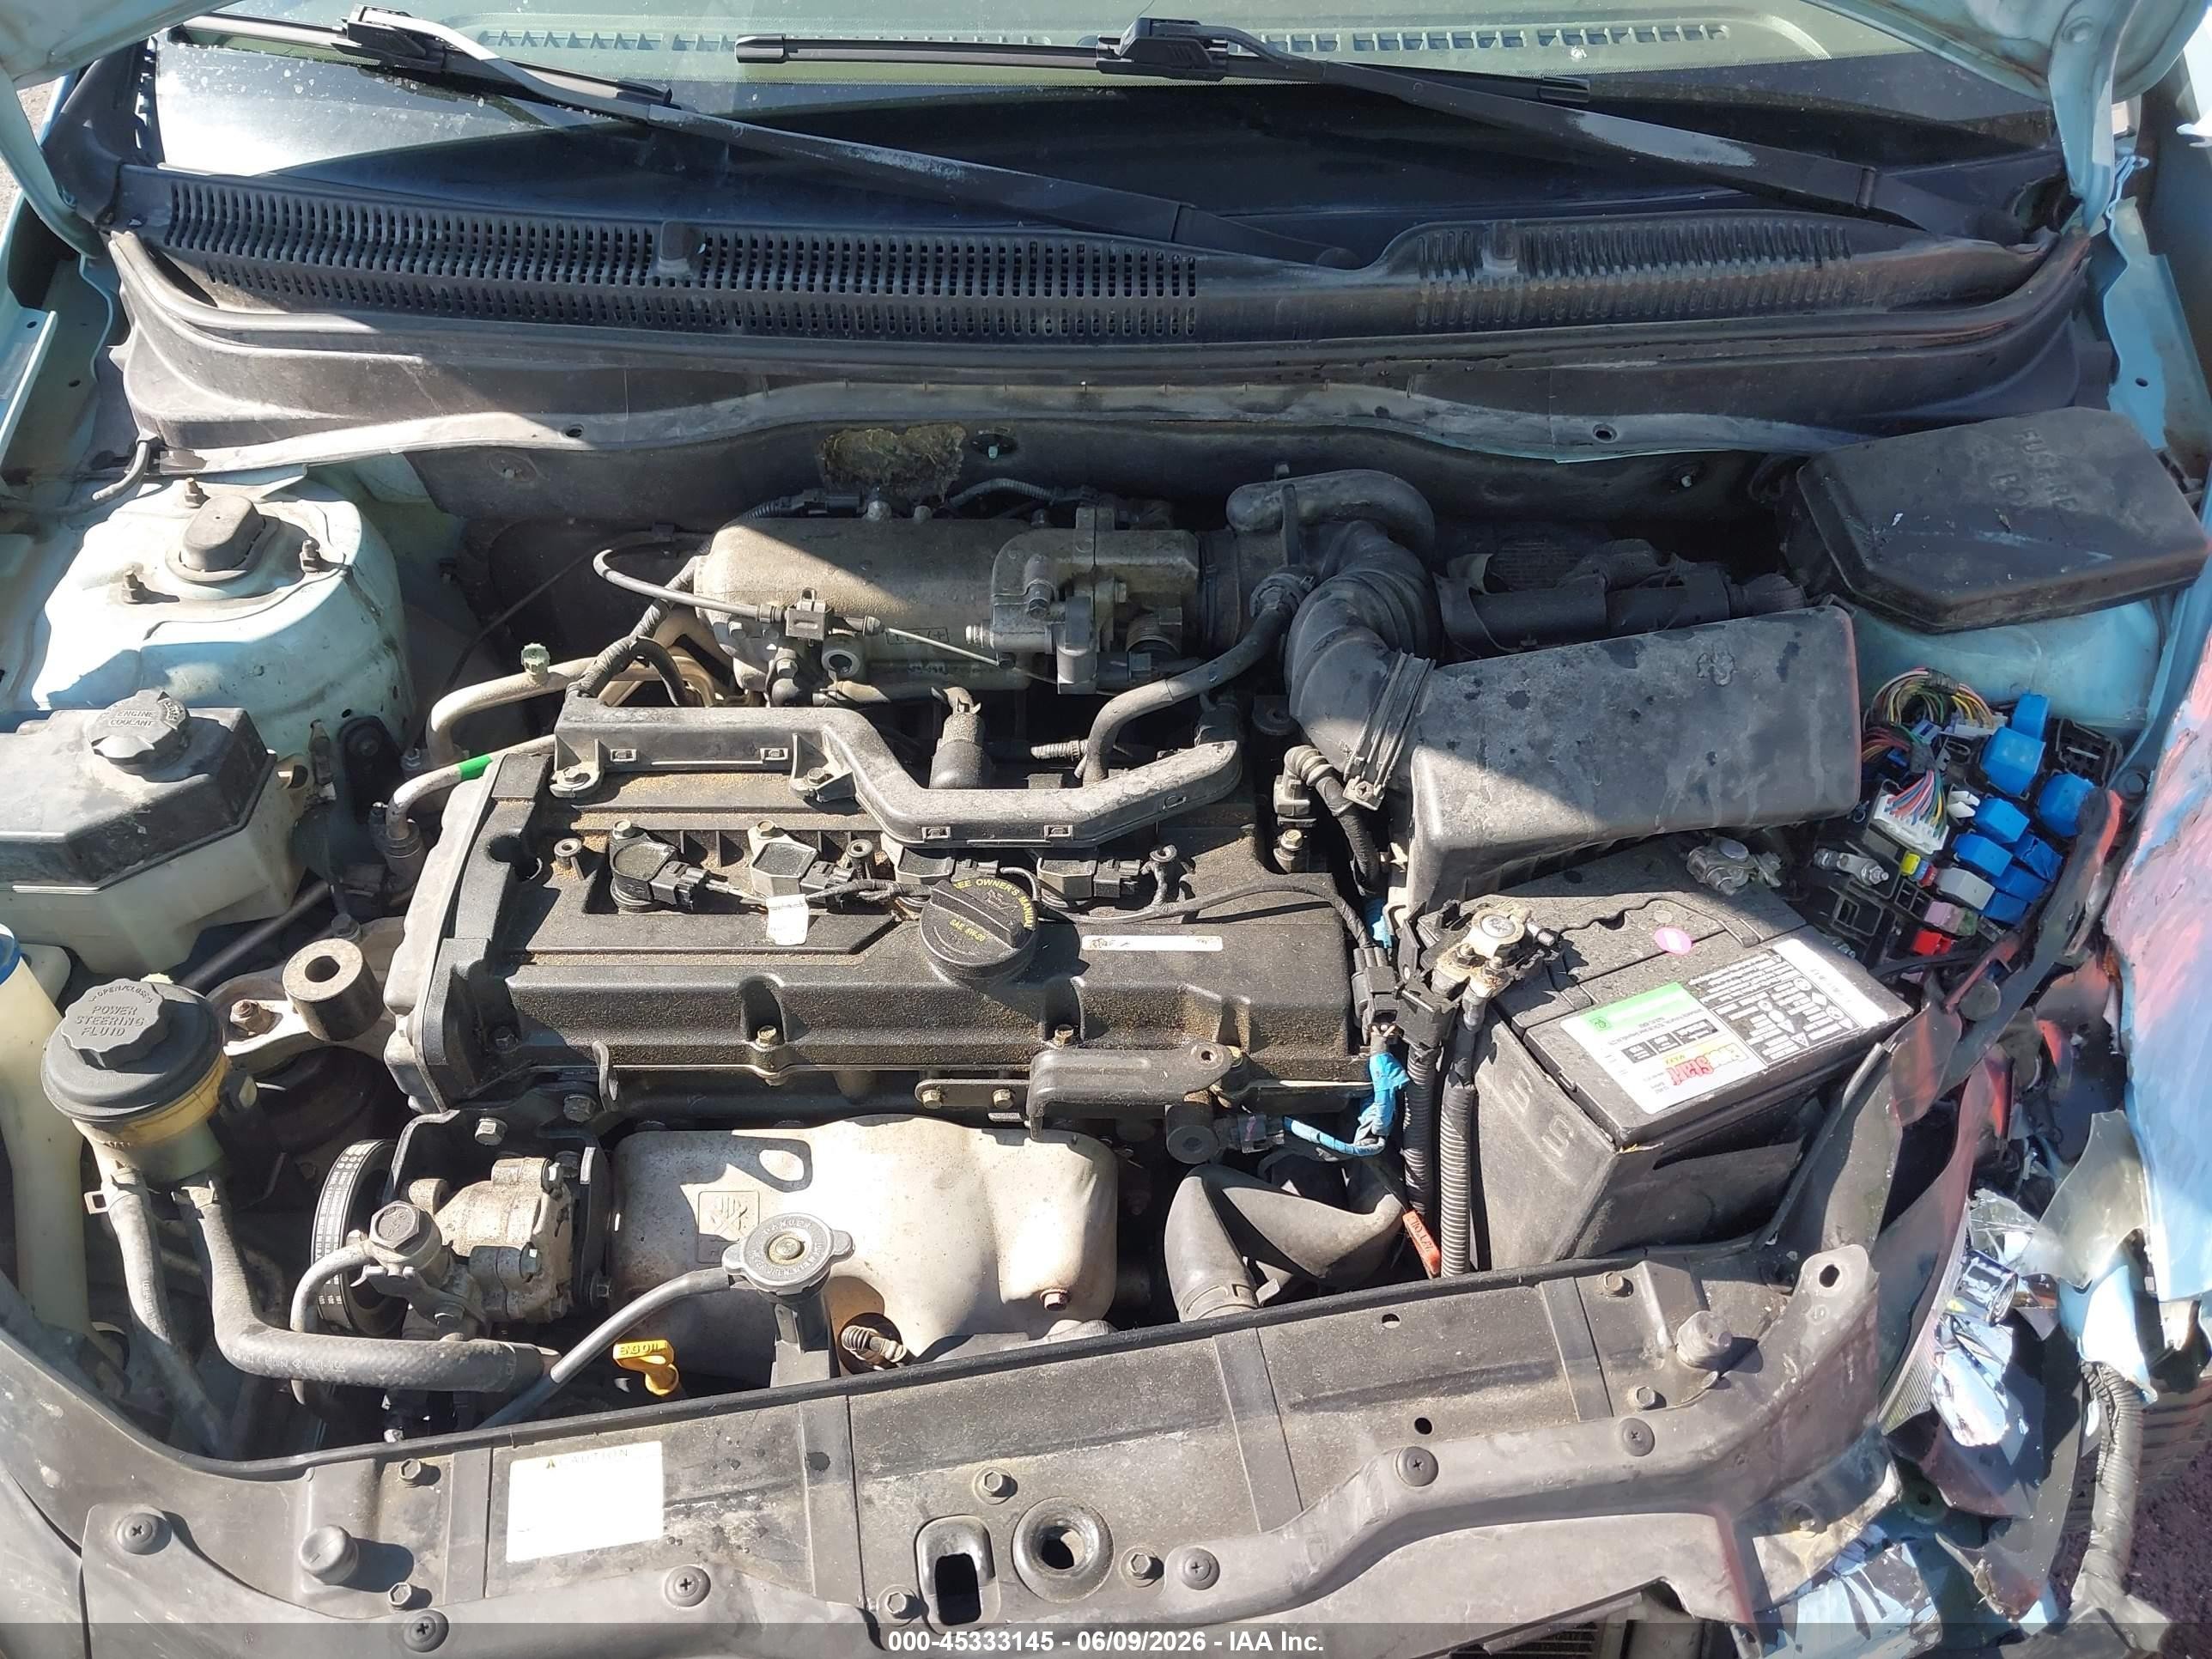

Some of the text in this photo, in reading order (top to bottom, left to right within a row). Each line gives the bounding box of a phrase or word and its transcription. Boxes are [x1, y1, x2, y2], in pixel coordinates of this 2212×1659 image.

[975, 878, 1020, 896] OWNER'S
[949, 919, 966, 931] SAE
[92, 1006, 138, 1016] POWER
[76, 1016, 145, 1027] STEERING
[81, 1026, 125, 1037] FLUID
